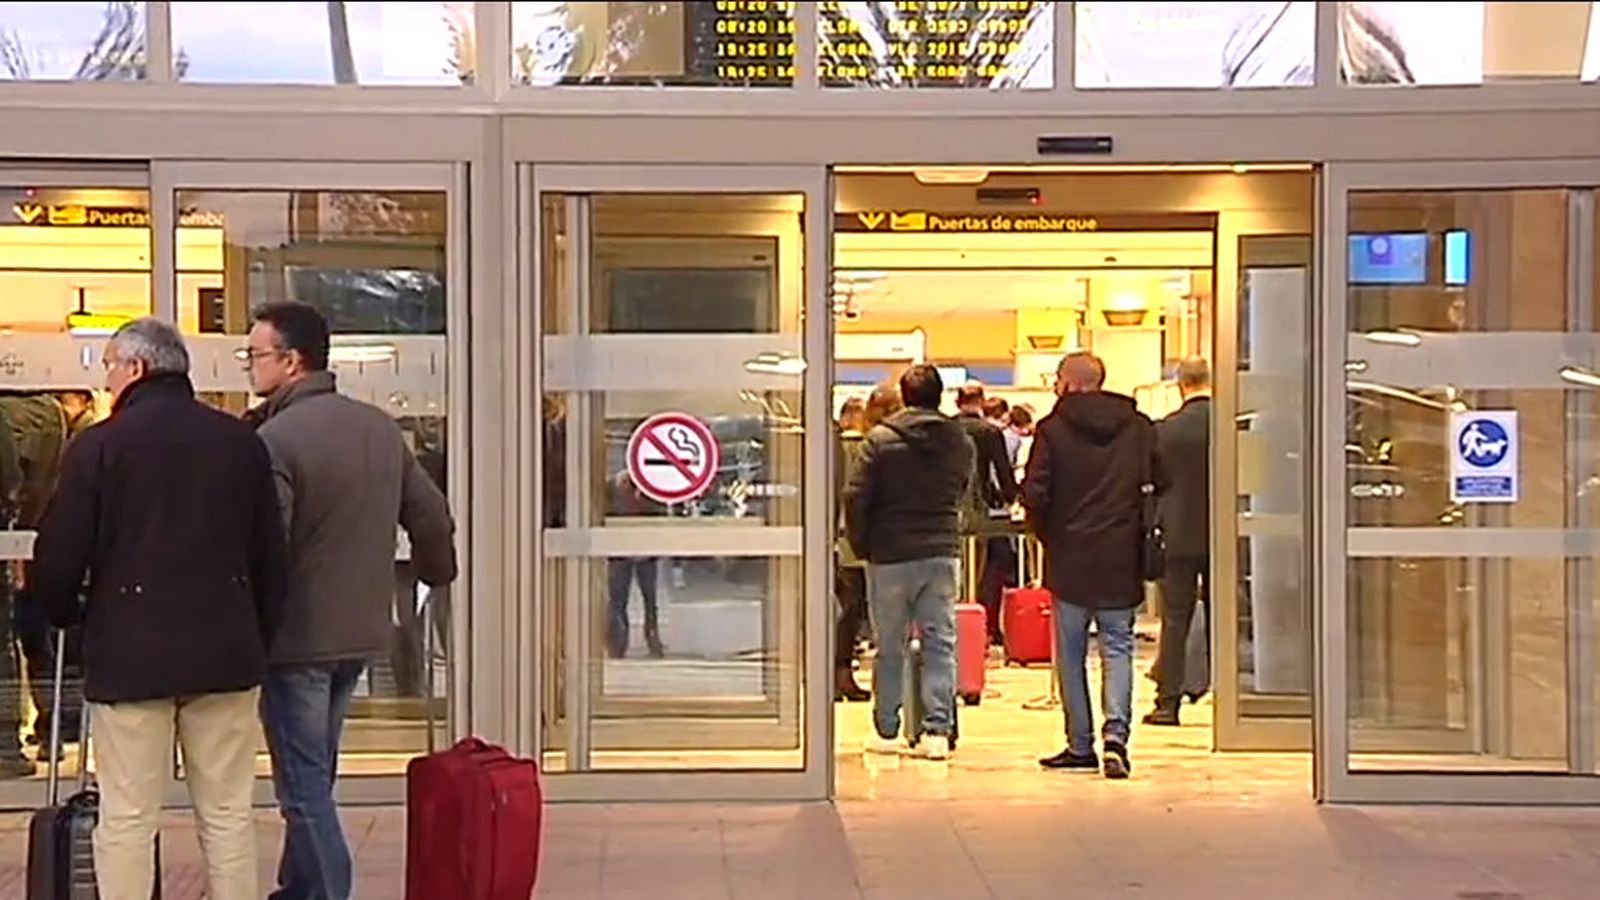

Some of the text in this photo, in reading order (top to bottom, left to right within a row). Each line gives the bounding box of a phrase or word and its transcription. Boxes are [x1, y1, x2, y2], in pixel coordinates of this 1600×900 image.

[929, 216, 1098, 232] Puertas de embarque
